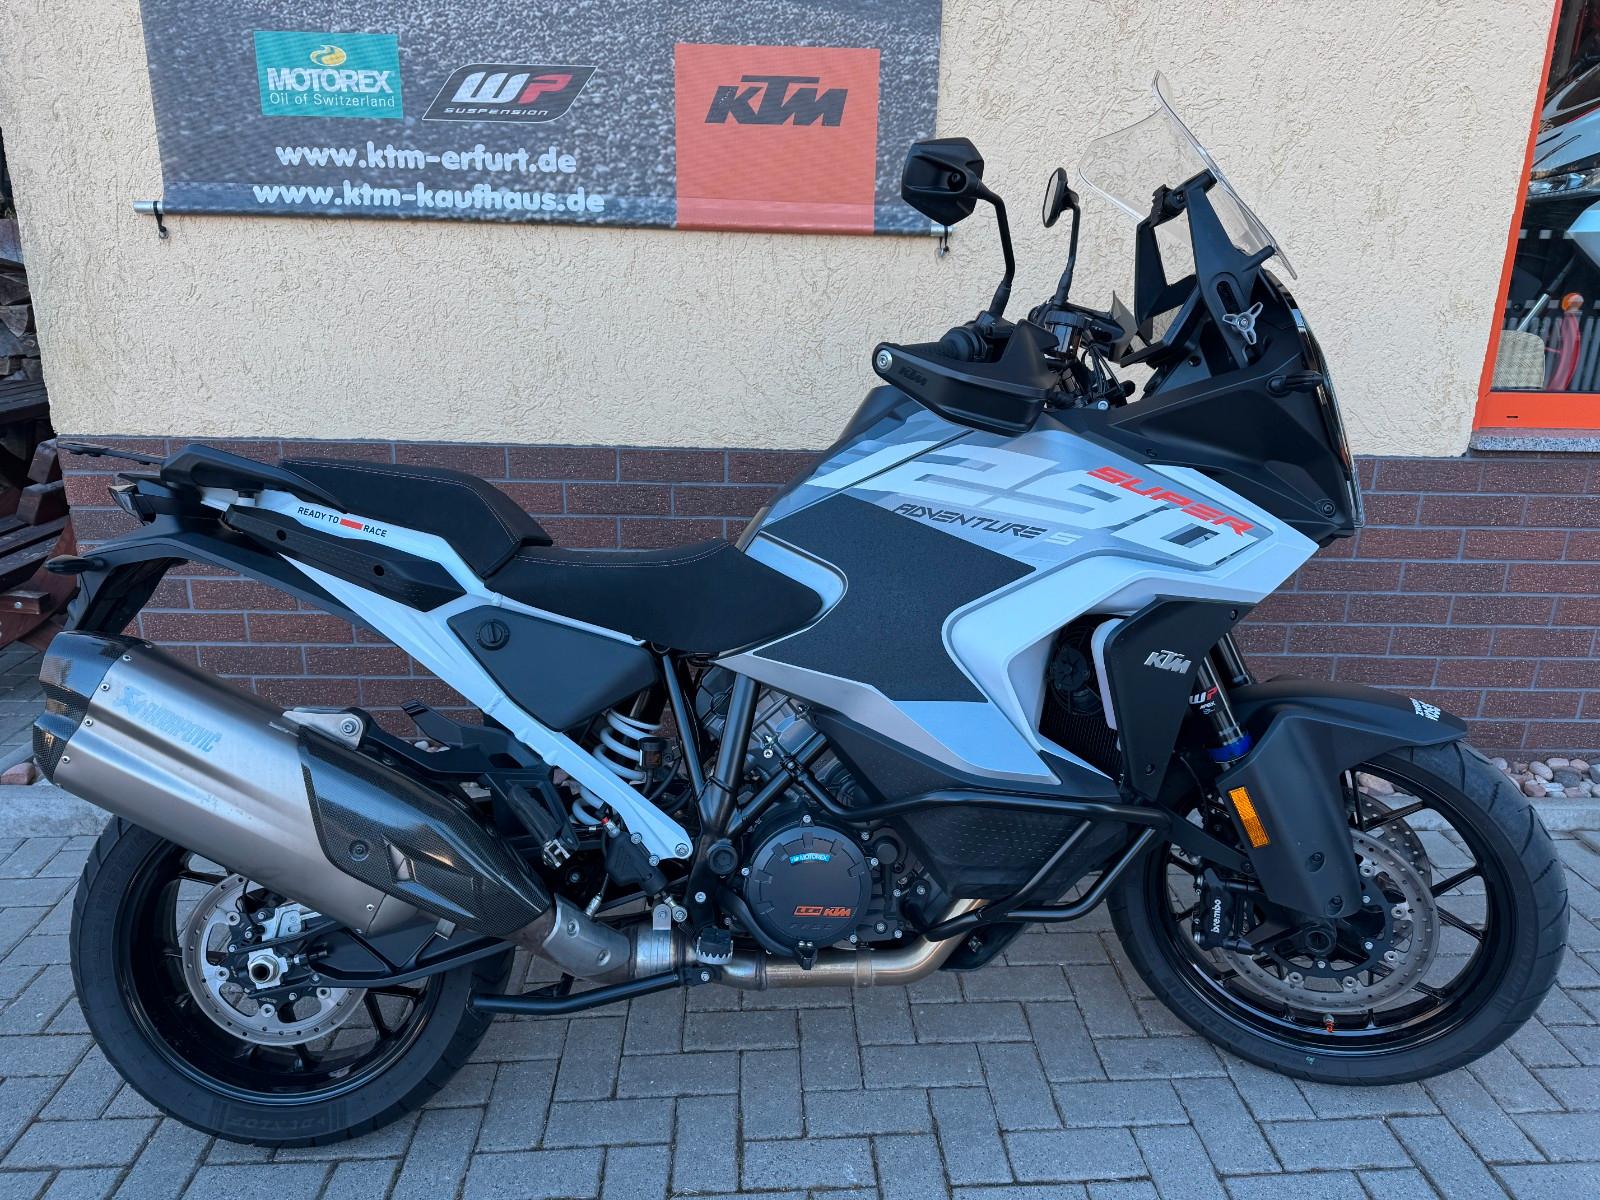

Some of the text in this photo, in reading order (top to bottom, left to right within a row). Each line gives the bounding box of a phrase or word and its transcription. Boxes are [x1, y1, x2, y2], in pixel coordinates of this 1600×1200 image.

[267, 67, 393, 94] MOTOREX
[451, 71, 573, 104] WP
[270, 92, 395, 108] Oil of Switzerland
[704, 74, 849, 127] KTM
[275, 140, 577, 173] www.ktm-erfurt.de
[252, 179, 605, 212] www.ktm-kaufhaus.de
[1087, 465, 1256, 537] SUPER
[297, 506, 388, 538] READY TO RACE
[893, 503, 1048, 539] ADVENTURE
[1144, 649, 1192, 675] KTM
[1188, 686, 1218, 704] WP
[799, 852, 831, 862] MOTOREX
[823, 907, 852, 917] KTM
[1210, 898, 1221, 934] brembo
